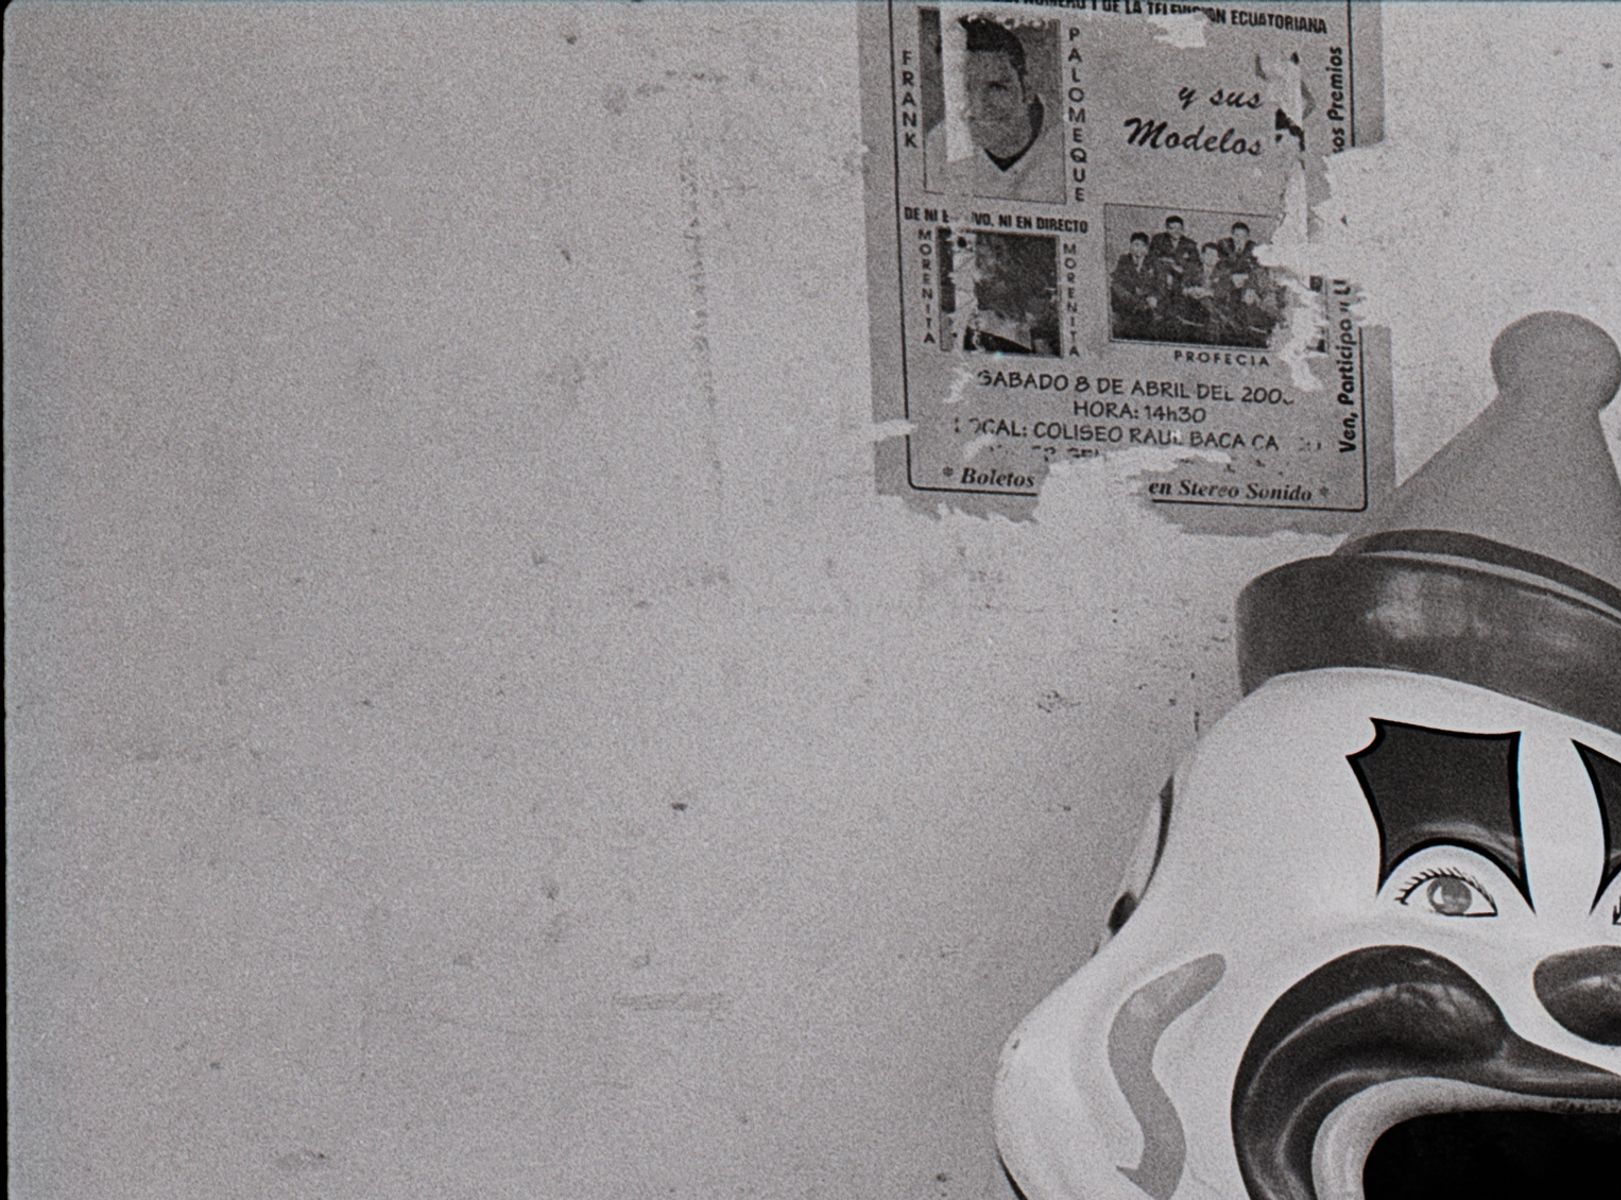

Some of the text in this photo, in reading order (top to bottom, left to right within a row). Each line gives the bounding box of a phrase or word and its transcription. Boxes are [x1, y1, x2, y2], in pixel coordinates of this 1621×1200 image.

[1231, 11, 1328, 35] ECUATORIANA
[901, 50, 918, 149] FRANK
[1178, 85, 1263, 110] y sus
[1324, 46, 1345, 122] Premios
[1067, 27, 1088, 202] PALOMEQUE
[1124, 117, 1263, 156] Modelos
[904, 206, 921, 221] DE
[999, 214, 1012, 227] NI
[1016, 215, 1033, 229] EN
[1036, 217, 1089, 234] DIRECTO
[917, 229, 936, 345] MORENITA
[1062, 243, 1080, 358] MORENITA
[1174, 350, 1271, 367] PROFECIA
[1336, 319, 1357, 405] Participa
[977, 369, 1296, 406] SABADO 8 DE ABRIL DEL 200
[1072, 400, 1207, 424] HORA: 14h30
[1033, 420, 1124, 443] COLISEO
[1190, 431, 1245, 449] BACA
[1339, 412, 1359, 453] Ven,
[960, 466, 1313, 502] Boletos en Stereo Sonido
